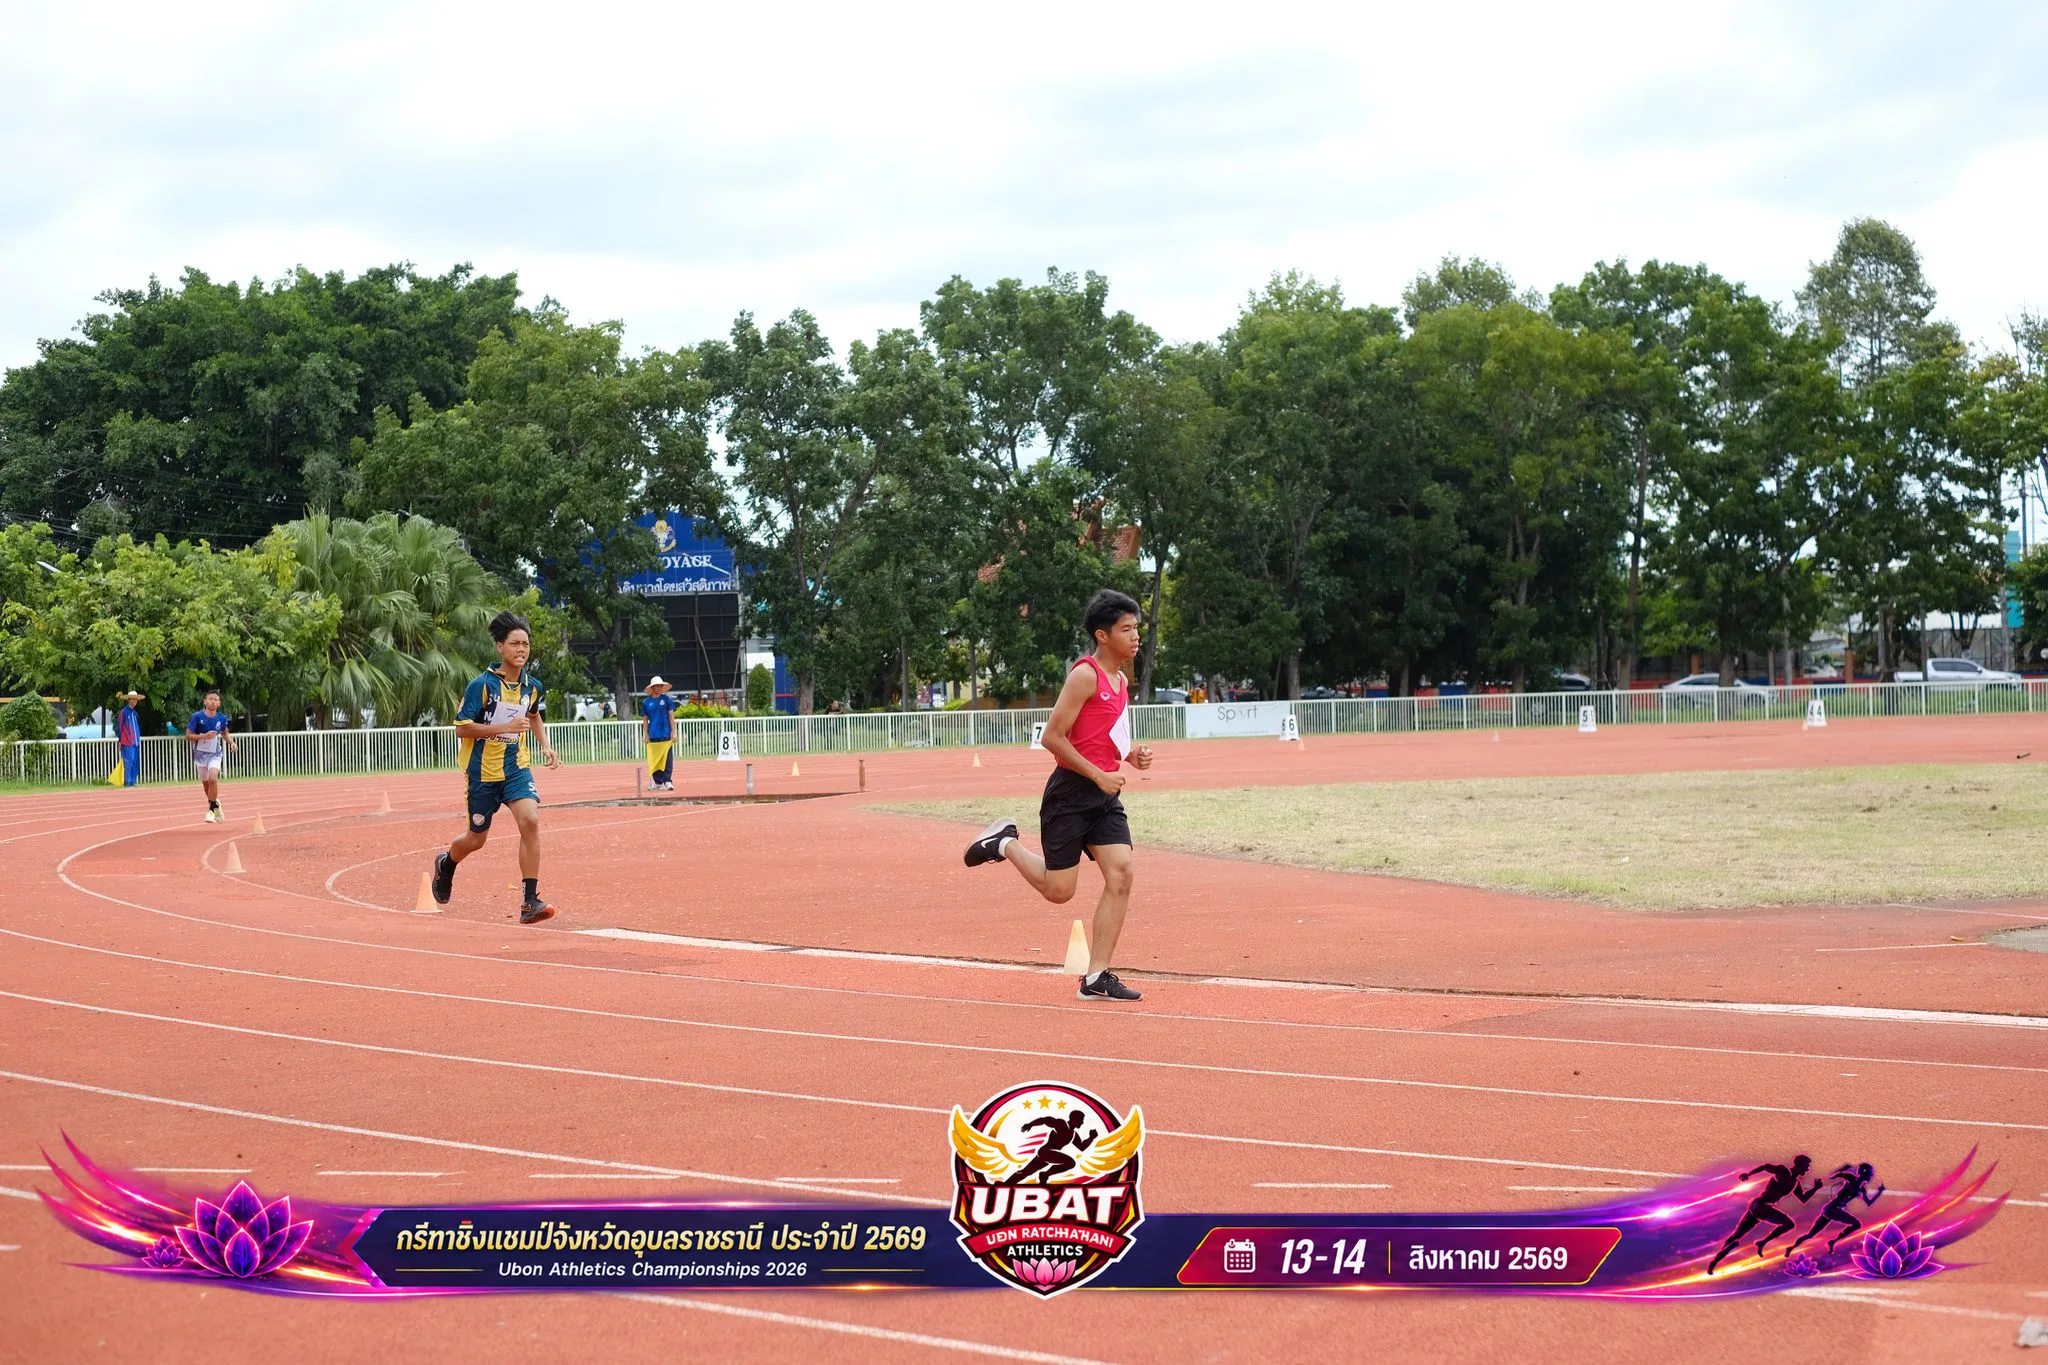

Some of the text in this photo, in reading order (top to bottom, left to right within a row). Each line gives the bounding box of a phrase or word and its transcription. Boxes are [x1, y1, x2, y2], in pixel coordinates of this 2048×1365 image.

[658, 554, 712, 569] OYAGE
[1582, 710, 1588, 723] 5
[1289, 718, 1295, 732] 6
[1035, 726, 1042, 739] 7
[722, 736, 729, 750] 8
